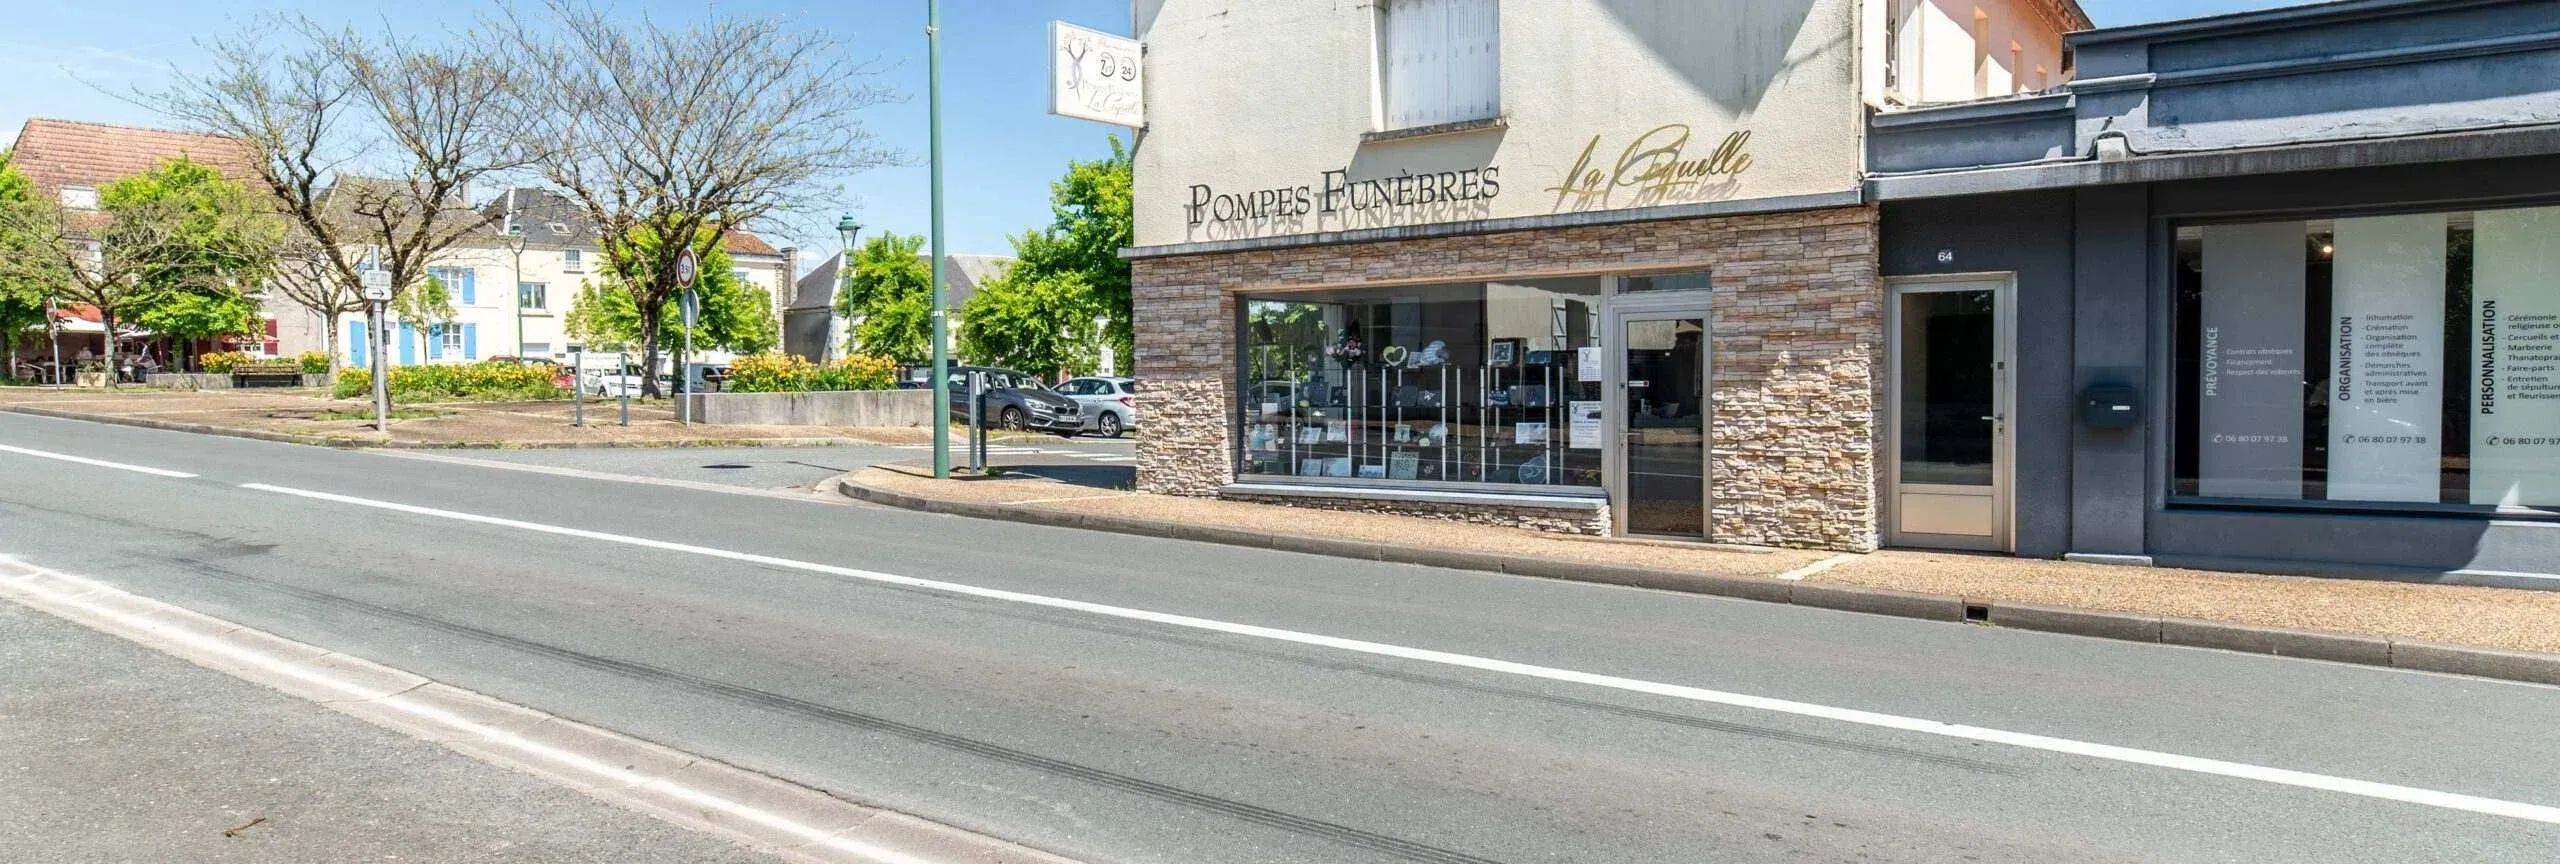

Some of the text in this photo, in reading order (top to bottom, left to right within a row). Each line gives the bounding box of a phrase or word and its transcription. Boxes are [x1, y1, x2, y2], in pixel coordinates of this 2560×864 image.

[1544, 133, 1606, 194] La
[1937, 251, 1952, 261] 64
[2508, 323, 2551, 331] religieuse
[2508, 333, 2548, 341] Cercueils
[2338, 316, 2352, 401] ORGANISATION
[2481, 300, 2496, 415] PERSONNALISATION
[2503, 437, 2516, 445] 06
[2533, 437, 2546, 445] 07
